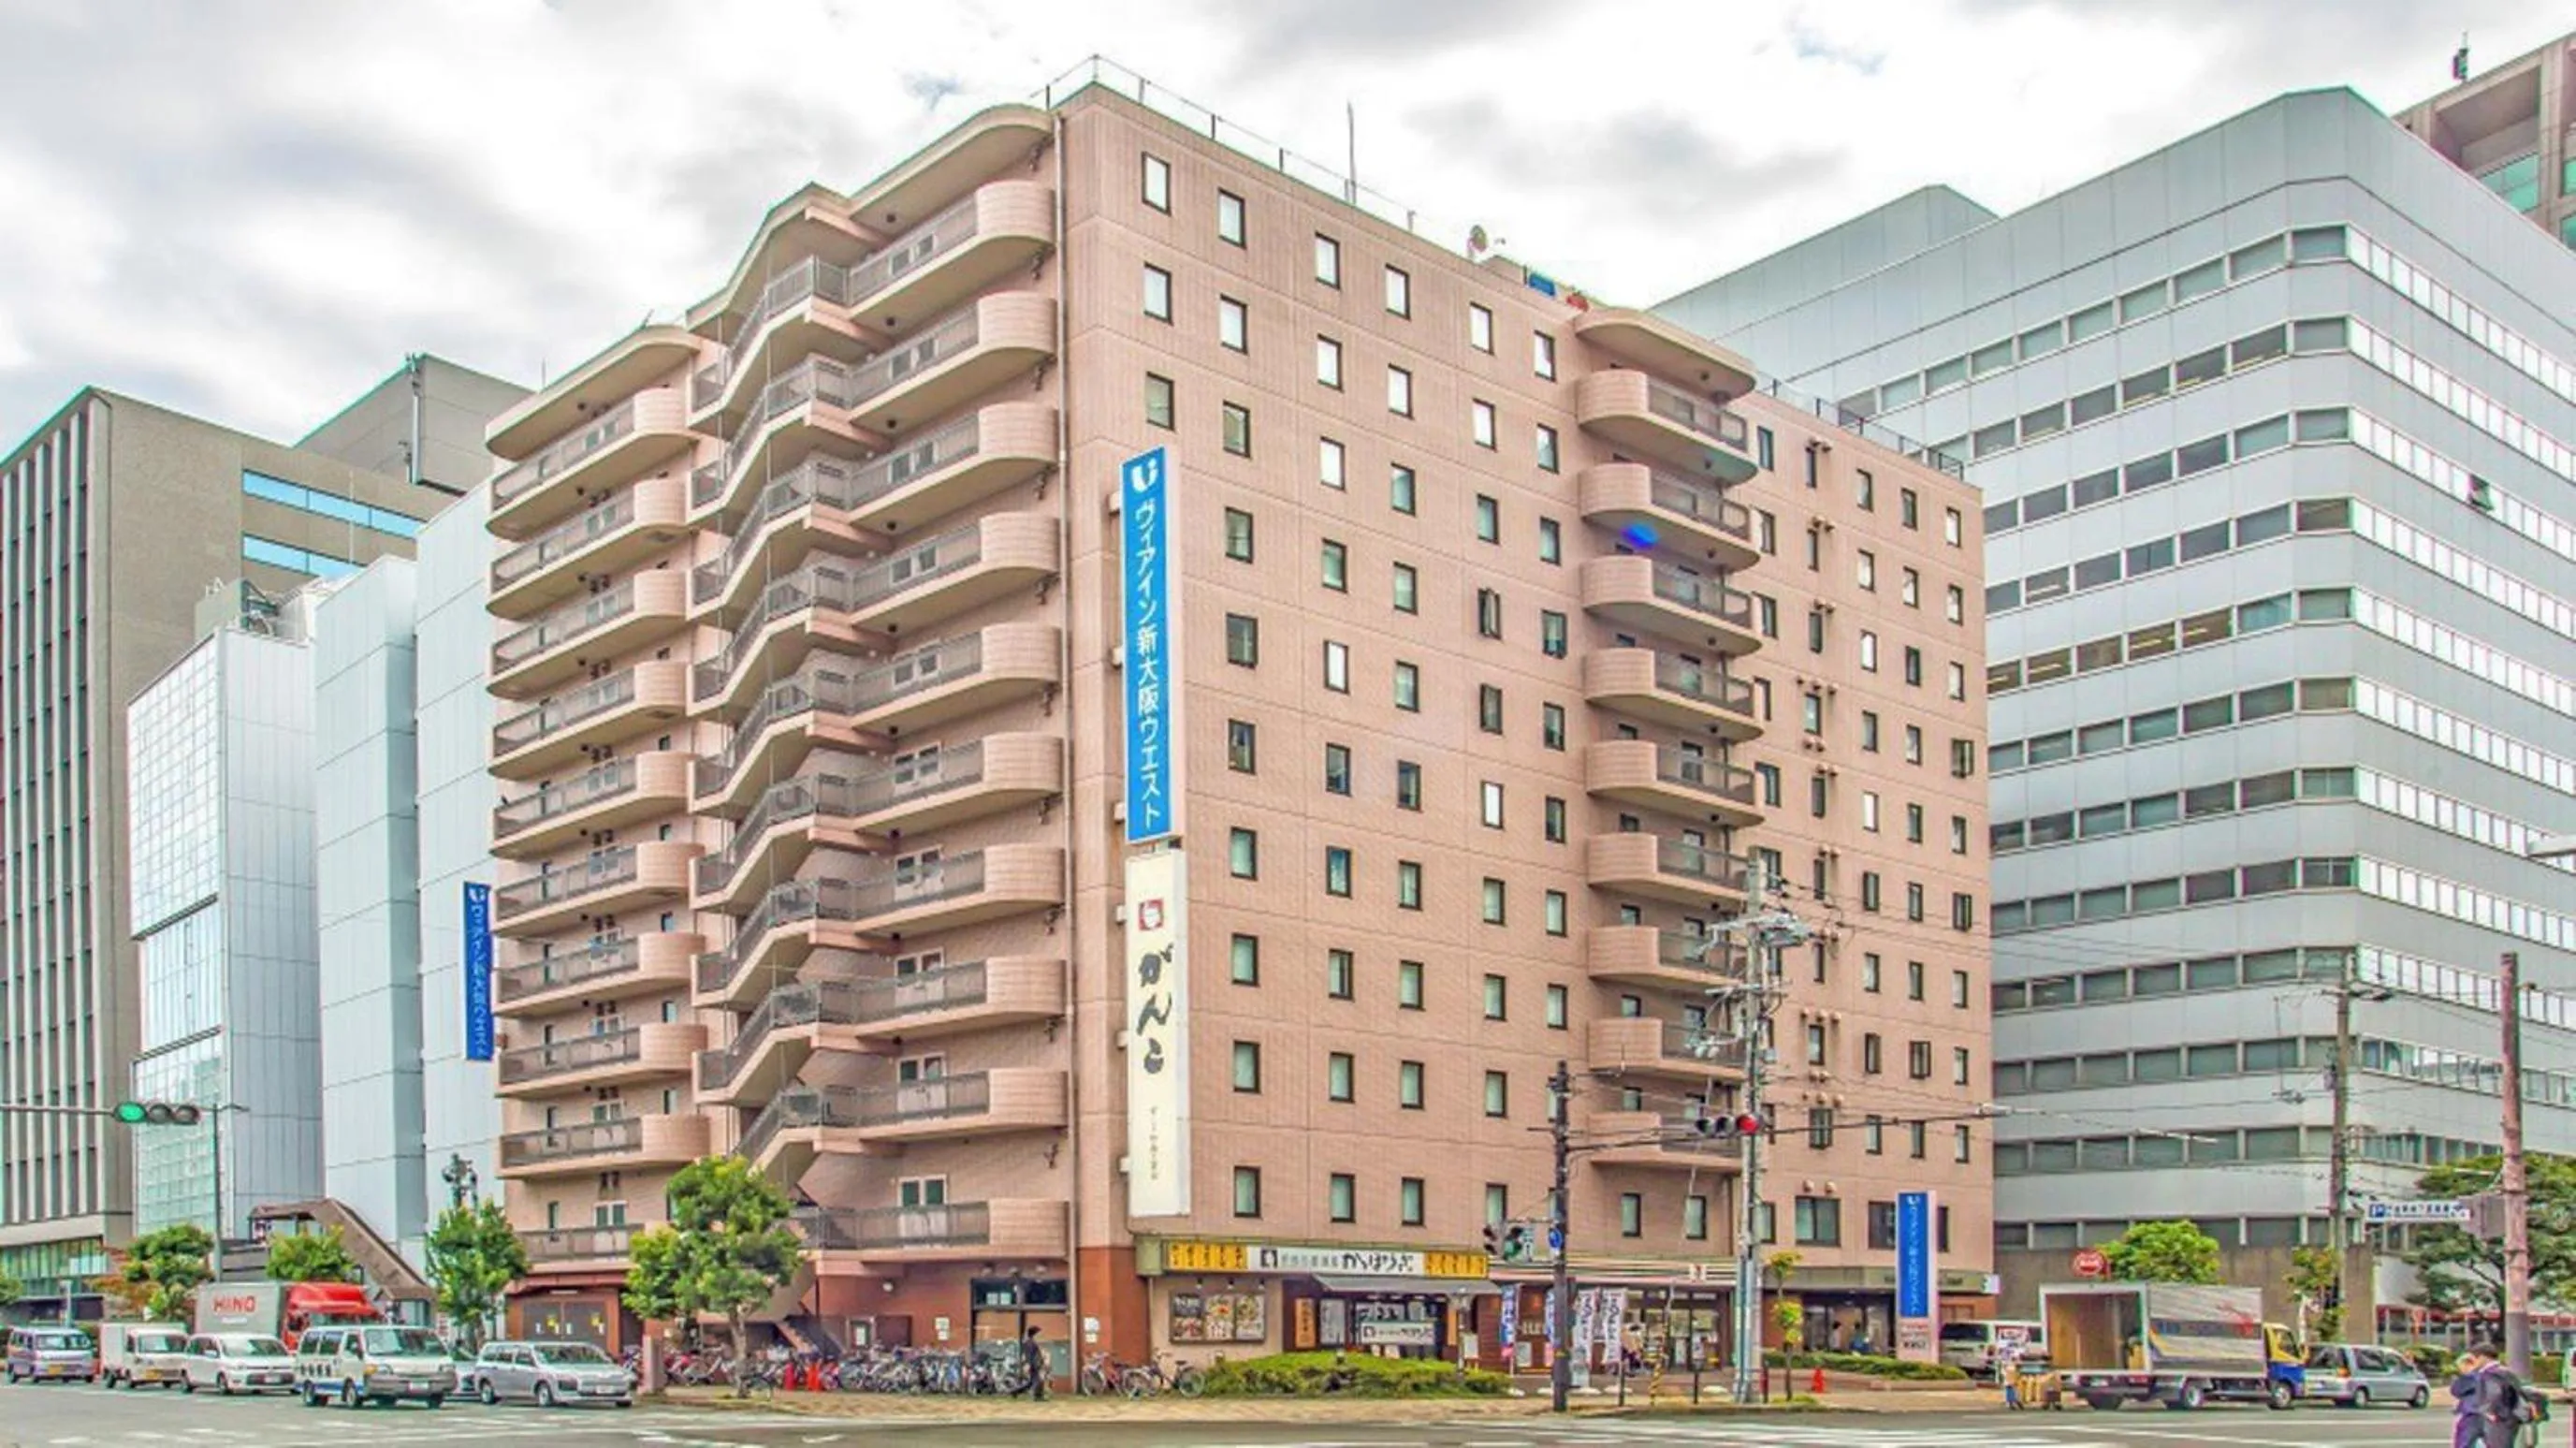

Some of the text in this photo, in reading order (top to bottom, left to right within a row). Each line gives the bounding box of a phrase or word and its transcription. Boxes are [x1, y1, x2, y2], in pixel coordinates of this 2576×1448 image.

[1135, 497, 1161, 830] ヴィアイン新大阪ウエスト
[1136, 942, 1173, 1073] がんこ
